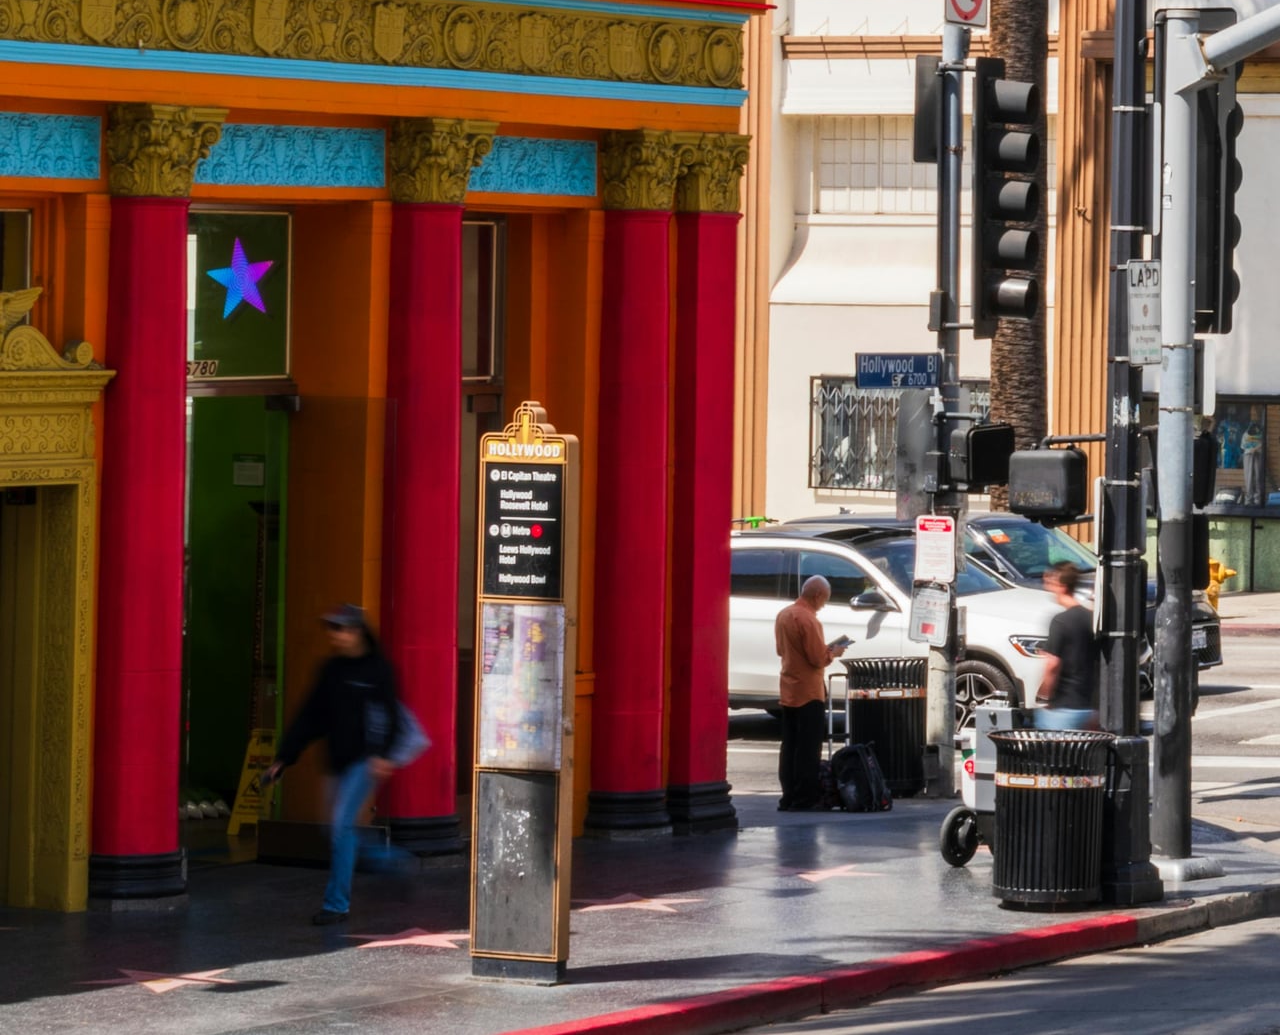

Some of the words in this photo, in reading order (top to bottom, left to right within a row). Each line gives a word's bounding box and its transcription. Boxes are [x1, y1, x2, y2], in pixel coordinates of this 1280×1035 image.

[1130, 268, 1159, 287] LAPD
[861, 355, 914, 378] Hollywood
[927, 355, 938, 373] Bl
[908, 372, 927, 385] 6700
[489, 443, 560, 457] HOLLYWOOD
[508, 470, 532, 482] Capitan
[532, 471, 557, 482] Theatre
[500, 489, 533, 501] Hollywood
[531, 500, 548, 511] Hotel
[512, 526, 531, 536] Metro
[499, 544, 518, 554] Loews
[519, 545, 551, 556] Hollywood
[499, 555, 516, 564] Hotel
[498, 573, 530, 585] Hollywood
